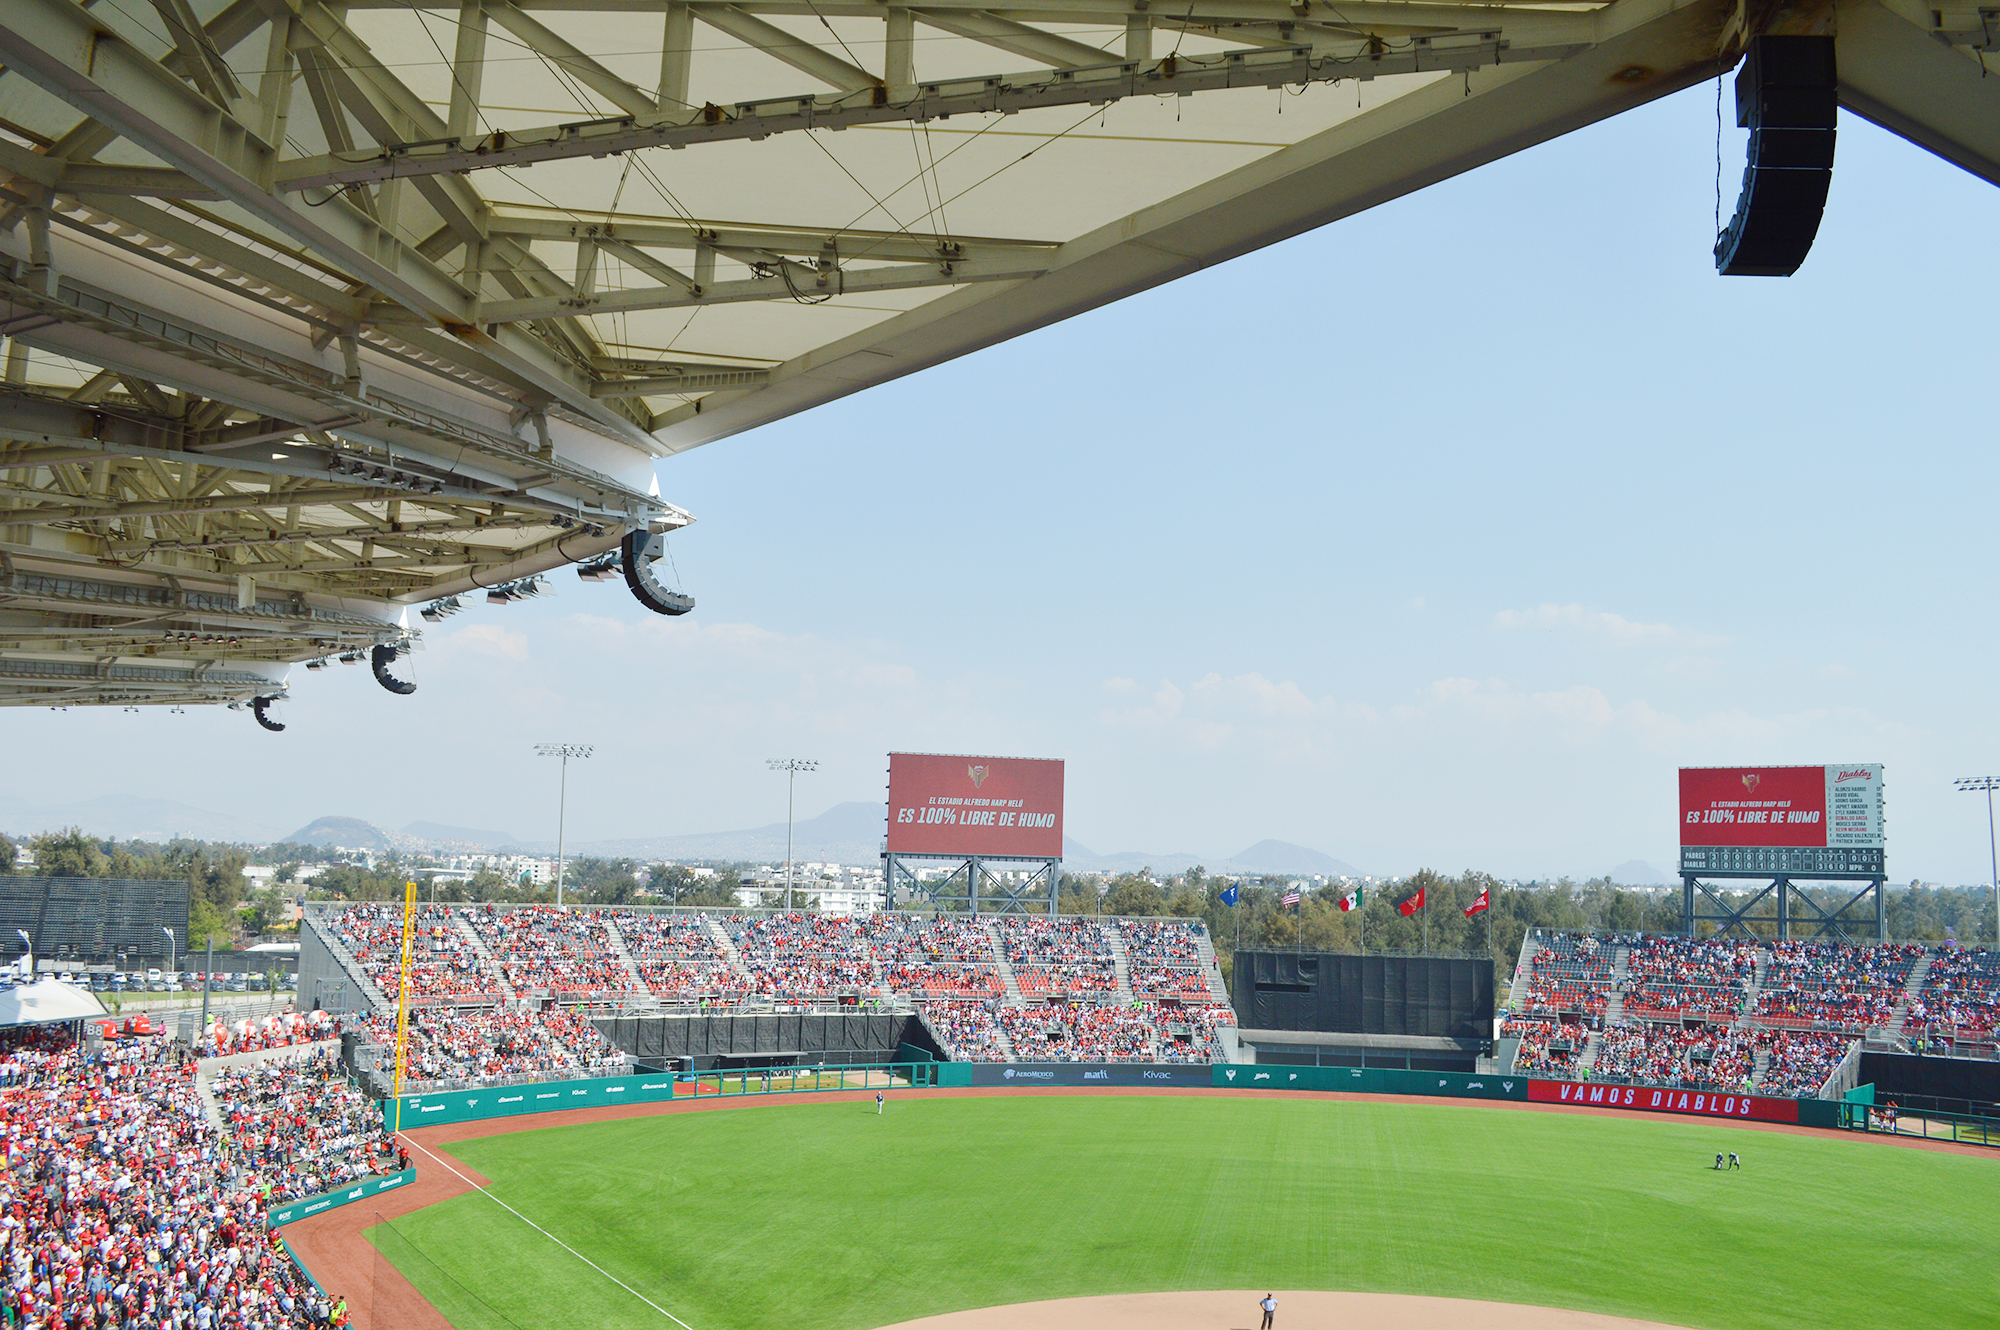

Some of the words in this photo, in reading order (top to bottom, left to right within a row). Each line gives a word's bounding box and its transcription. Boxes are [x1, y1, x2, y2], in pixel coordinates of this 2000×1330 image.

[1835, 768, 1872, 783] Diablos
[929, 797, 937, 805] EL
[938, 797, 964, 806] ESTADIO
[964, 798, 991, 807] ALFREDO
[991, 798, 1008, 808] HARP
[1008, 798, 1024, 808] HELÚ
[897, 808, 915, 824] ES
[916, 807, 957, 825] 100%
[959, 810, 996, 826] LIBRE
[998, 811, 1016, 827] DE
[1017, 812, 1056, 828] HUMO
[1686, 811, 1701, 823] ES
[1702, 809, 1735, 824] 100%
[1737, 811, 1769, 824] LIBRE
[1770, 811, 1786, 824] DE
[1787, 811, 1820, 824] HUMO
[87, 1025, 103, 1036] B8
[1560, 1084, 1635, 1105] VAMOS
[1651, 1091, 1751, 1115] DIABLOS
